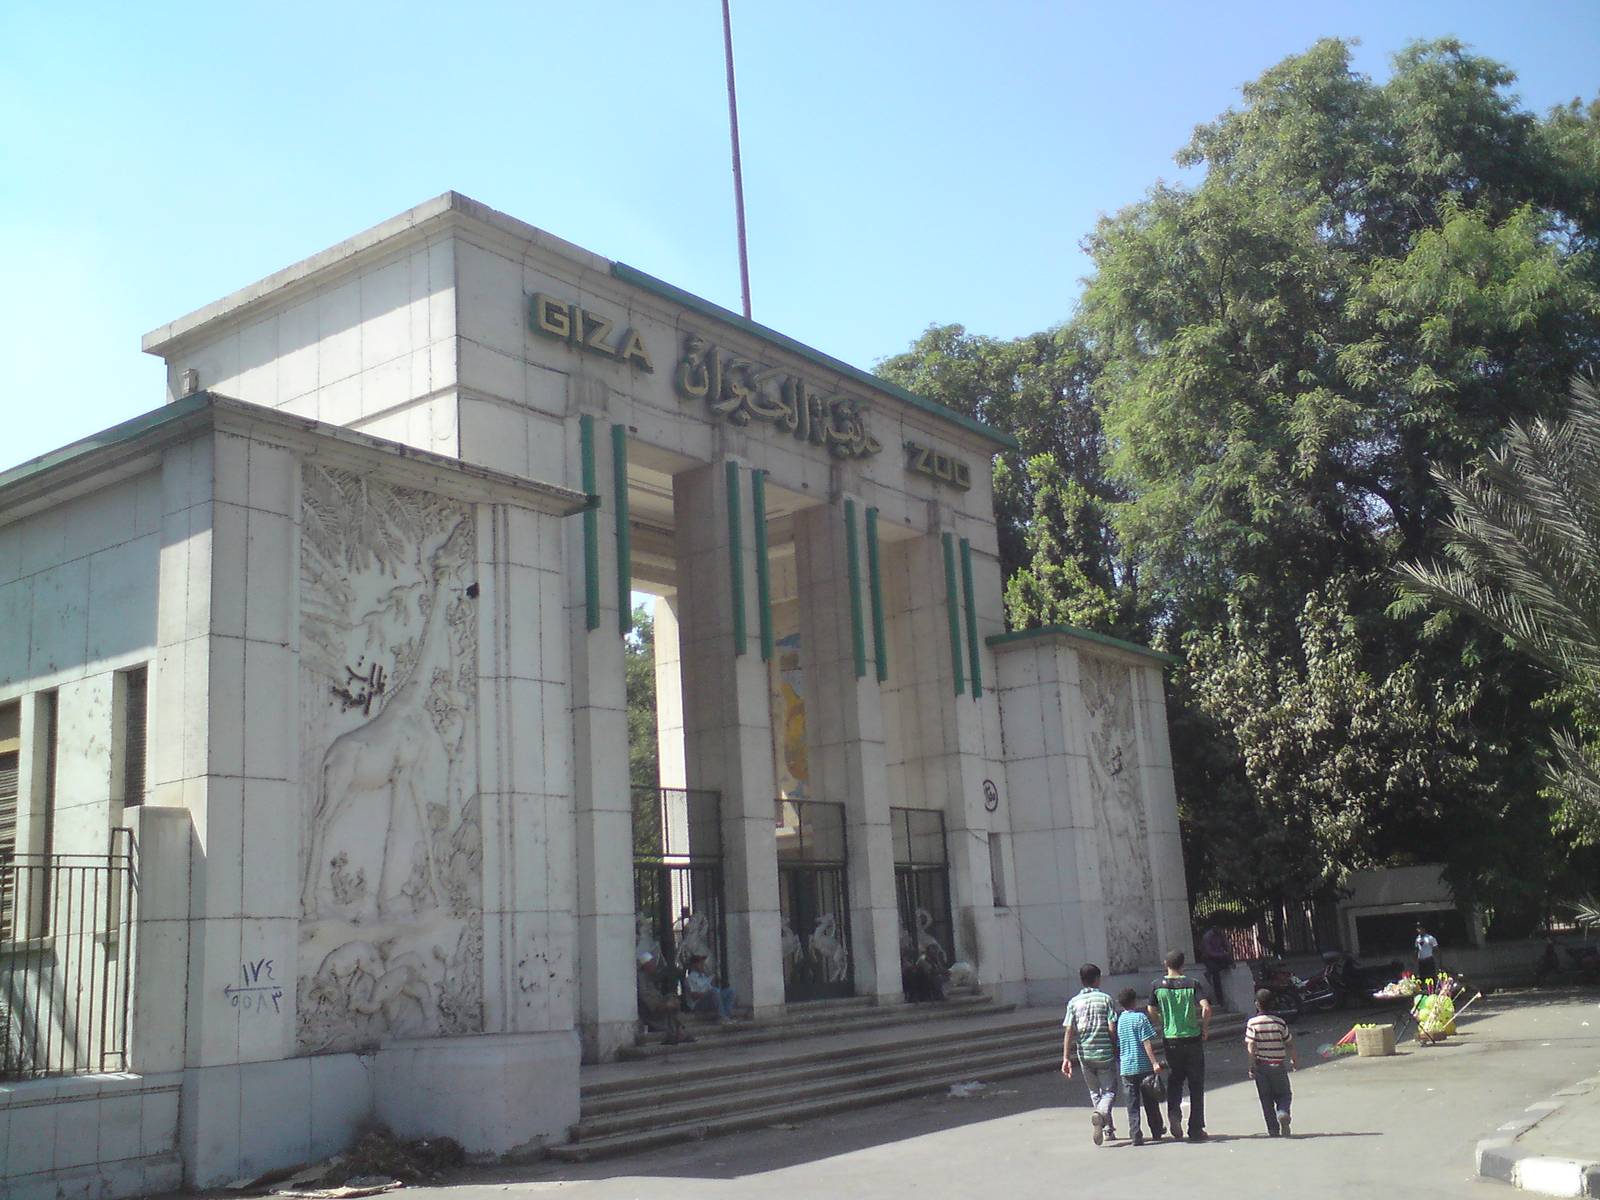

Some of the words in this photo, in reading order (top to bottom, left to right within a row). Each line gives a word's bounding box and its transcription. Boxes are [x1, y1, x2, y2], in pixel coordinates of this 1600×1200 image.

[531, 292, 654, 372] GIZA
[676, 335, 812, 440] الحيوان
[907, 442, 971, 491] ZOO
